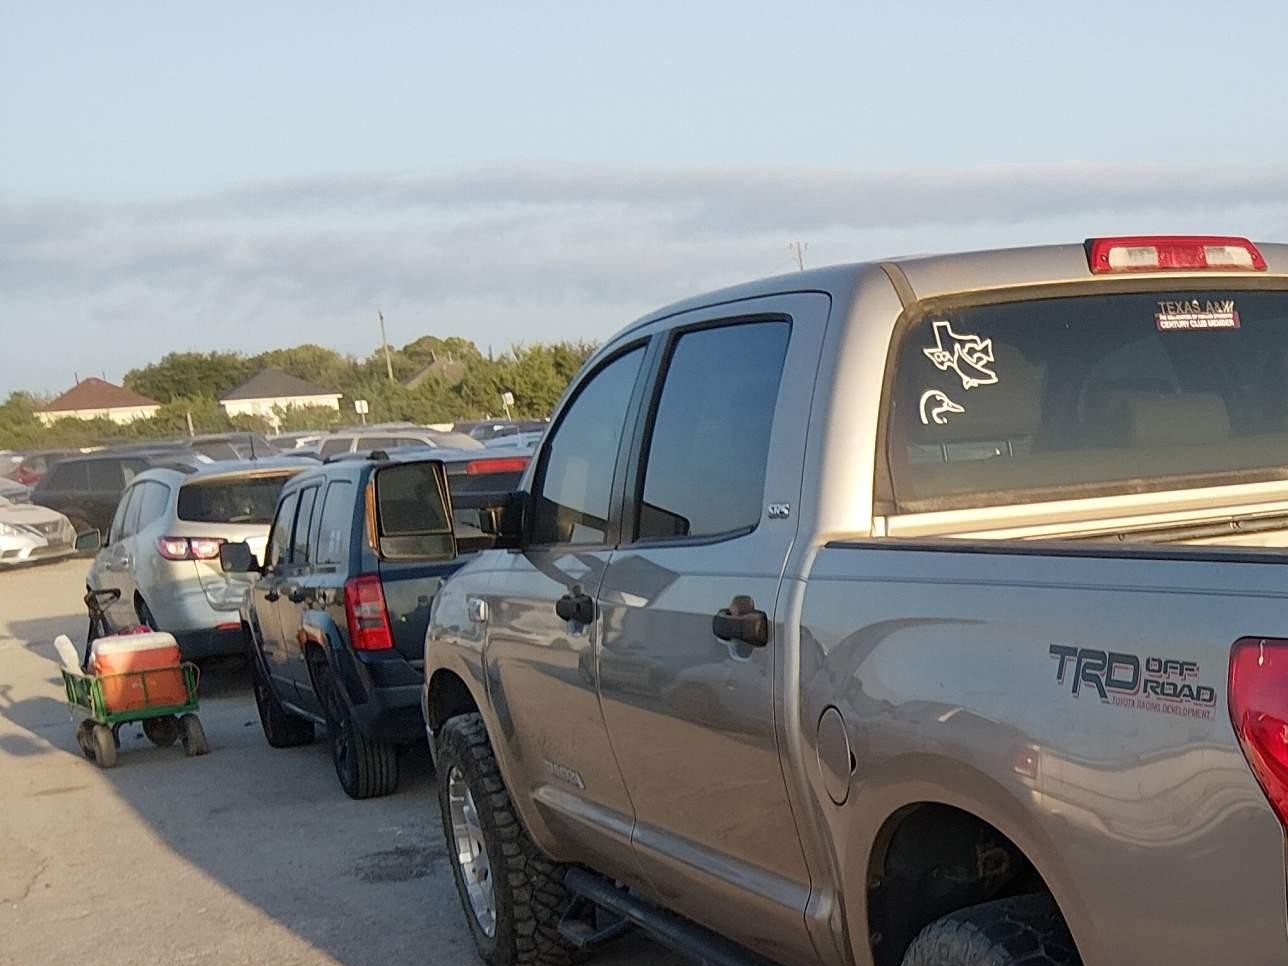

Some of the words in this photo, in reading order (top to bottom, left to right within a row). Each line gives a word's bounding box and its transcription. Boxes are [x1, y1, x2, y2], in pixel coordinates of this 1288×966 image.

[1157, 300, 1200, 315] TEXAS
[1049, 644, 1141, 702] TRD
[1145, 656, 1199, 681] OFF
[1143, 679, 1217, 707] ROAD
[1112, 696, 1136, 710] TOYOTA
[1136, 699, 1161, 714] RACING
[1162, 702, 1211, 721] DEVELOPMENT
